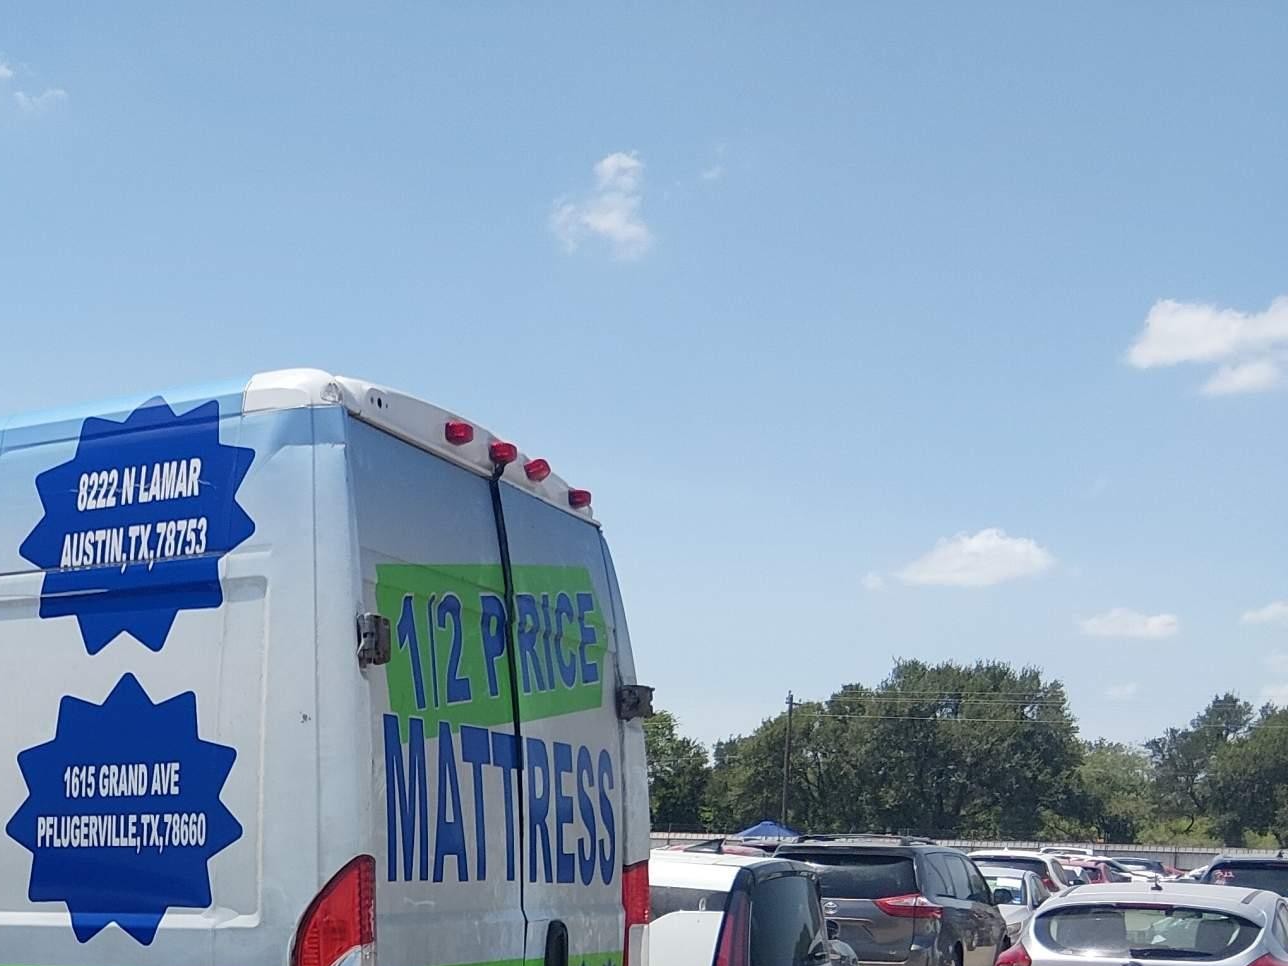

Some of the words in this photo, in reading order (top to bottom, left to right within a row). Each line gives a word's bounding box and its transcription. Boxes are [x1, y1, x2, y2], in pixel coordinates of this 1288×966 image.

[77, 470, 119, 512] 8222
[121, 466, 137, 506] N
[138, 457, 202, 503] LAMAR
[60, 516, 208, 574] AUSTIN,TX,78753
[396, 592, 473, 712] 1/2
[478, 591, 601, 699] PRICE
[64, 765, 96, 798] 1615
[98, 763, 148, 797] GRAND
[151, 762, 180, 796] AVE
[383, 713, 616, 886] MATTRESS
[37, 812, 206, 854] PFLUGERVILLE,TX,78660
